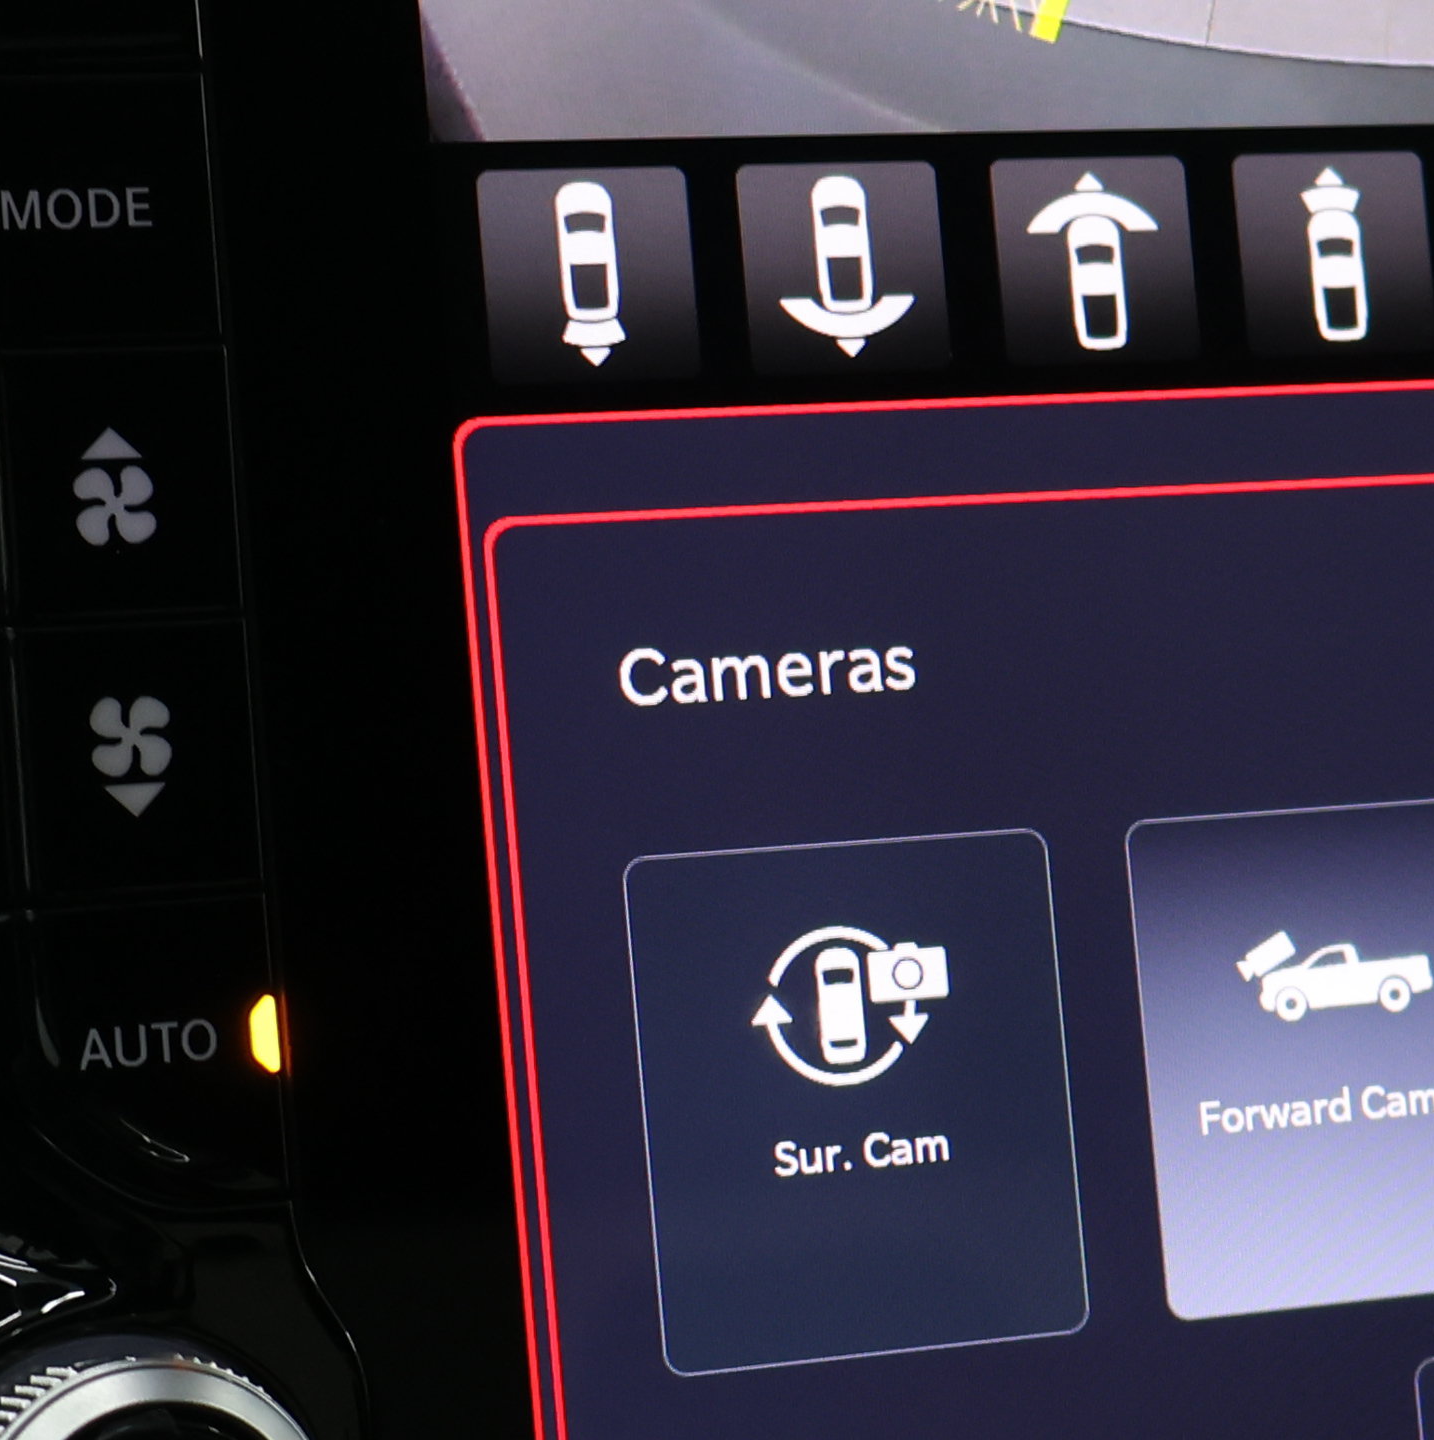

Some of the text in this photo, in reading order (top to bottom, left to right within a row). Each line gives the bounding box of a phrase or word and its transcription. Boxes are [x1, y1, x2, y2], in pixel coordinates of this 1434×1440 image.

[0, 186, 153, 231] MODE
[618, 645, 916, 707] Cameras
[80, 1018, 218, 1071] AUTO
[1199, 1087, 1353, 1136] Forward
[774, 1131, 950, 1177] Sur. Cam
